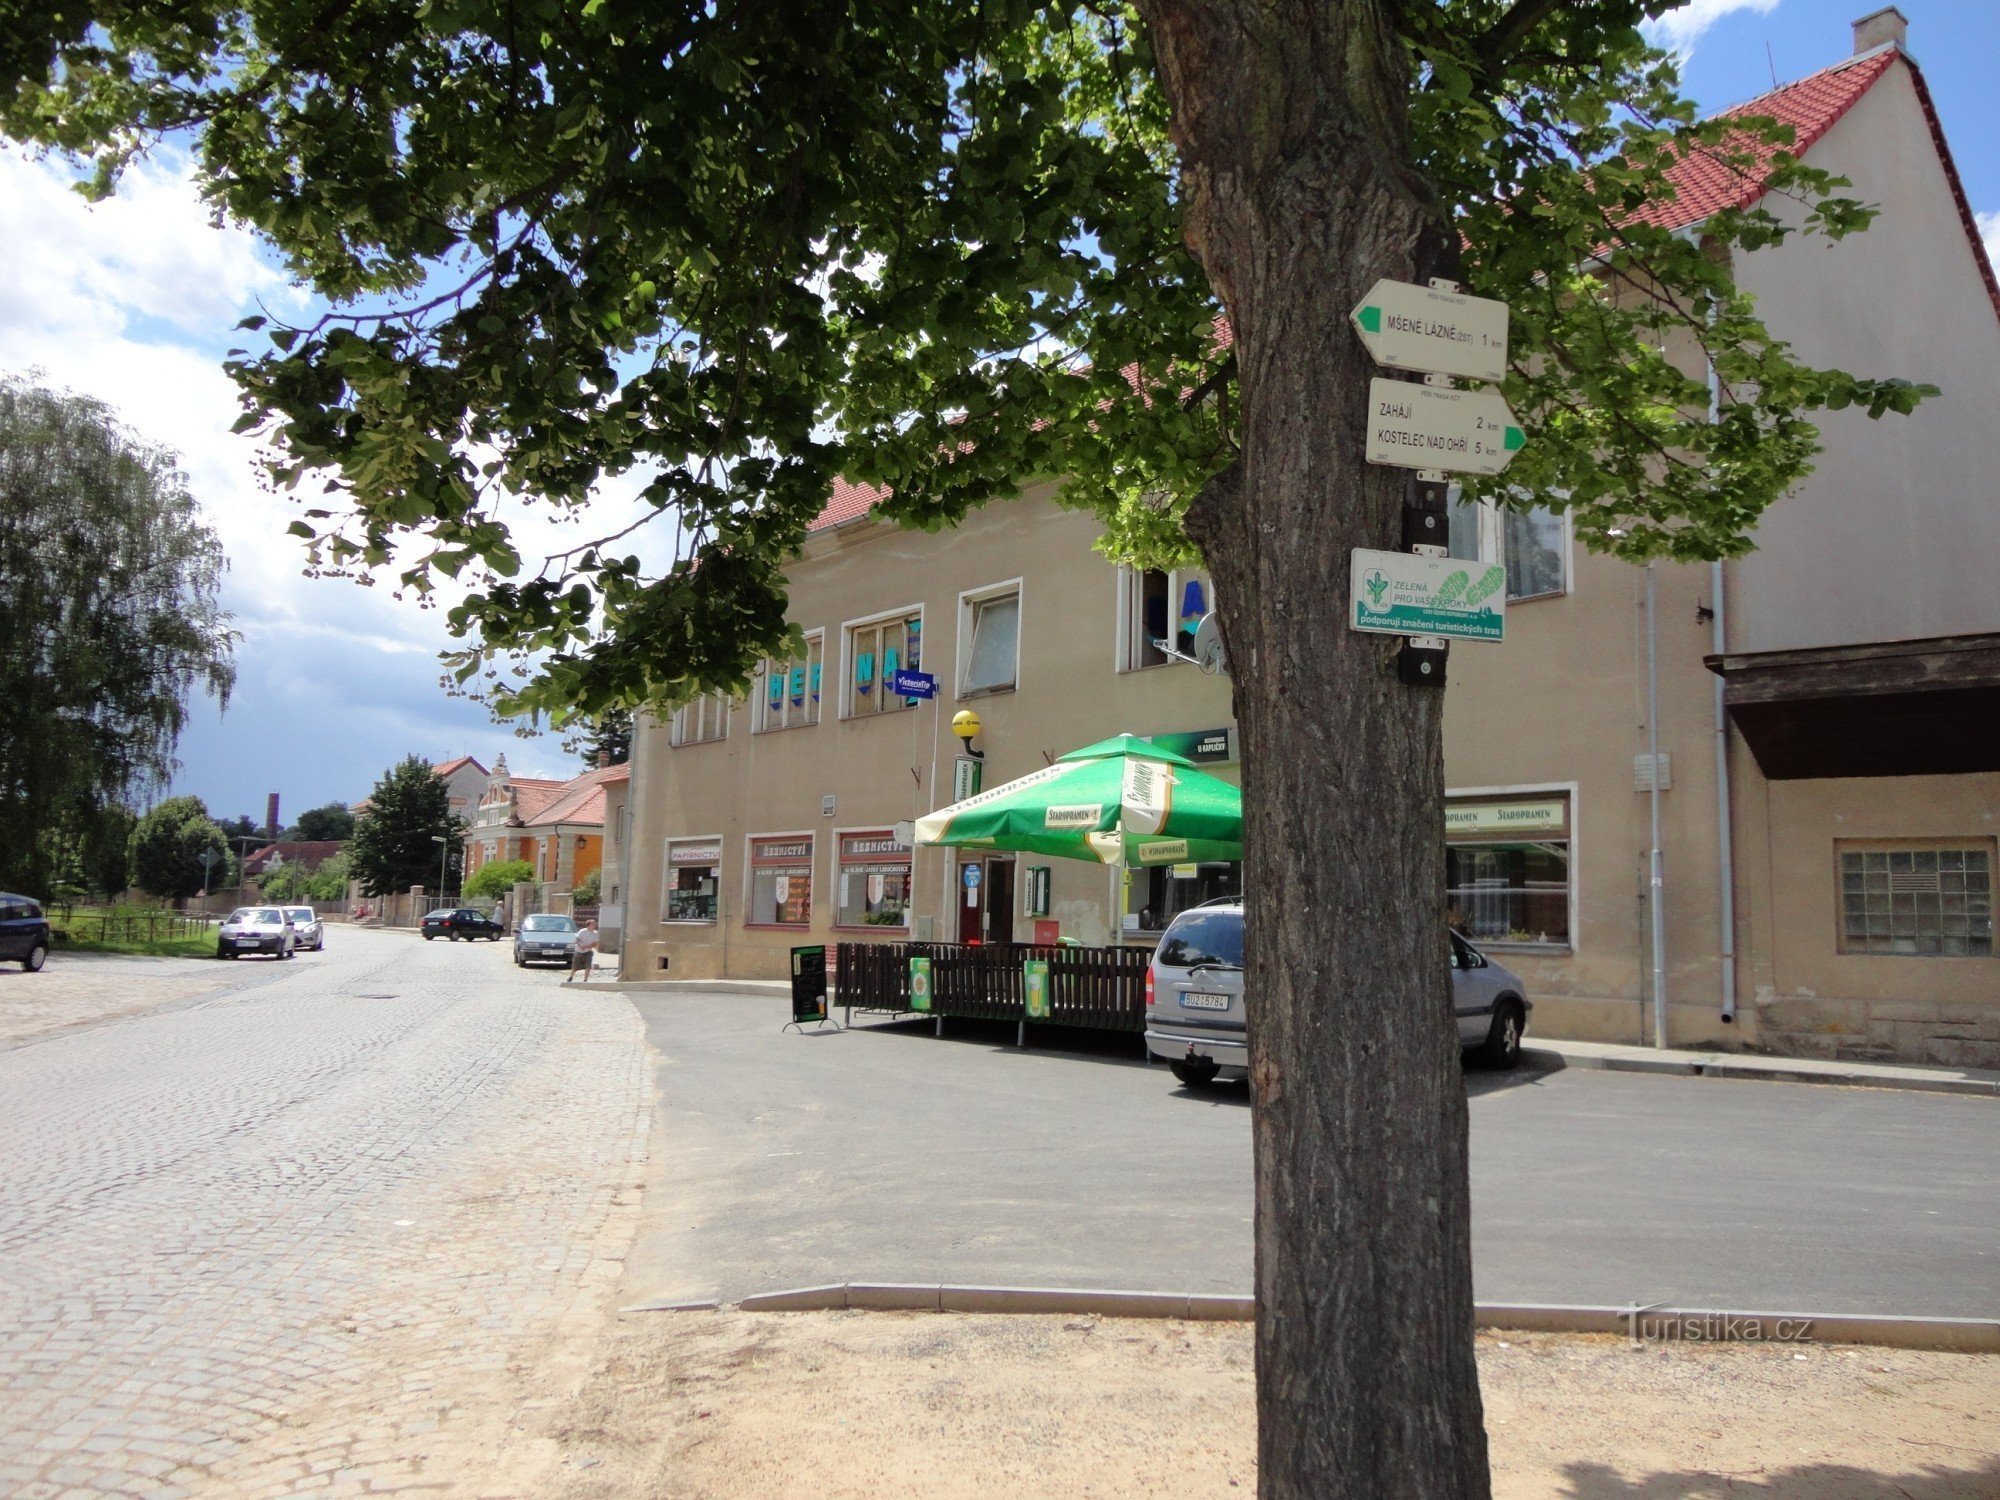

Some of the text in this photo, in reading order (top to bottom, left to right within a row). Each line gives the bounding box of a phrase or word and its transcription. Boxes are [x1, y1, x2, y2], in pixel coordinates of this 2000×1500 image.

[1388, 314, 1421, 334] MŠENÉ
[1425, 321, 1456, 340] LÁZNĚ
[1483, 334, 1487, 345] 1
[1491, 339, 1502, 348] km
[1380, 402, 1498, 431] ZAHÁJÍ 2 km
[1378, 429, 1496, 456] KOSTELEC NAD OHŘÍ 5 km
[1394, 581, 1428, 592] ZELENÁ
[1394, 594, 1467, 609] PRO VAŠE KROKY
[1360, 615, 1500, 635] podporují značení turistických tras
[1048, 809, 1090, 821] STAROPRAMEN
[1445, 809, 1551, 822] OPRAMEN STAROPRAMEN
[764, 843, 806, 857] ŘEZNICTVÍ
[1186, 995, 1200, 1006] 5U2
